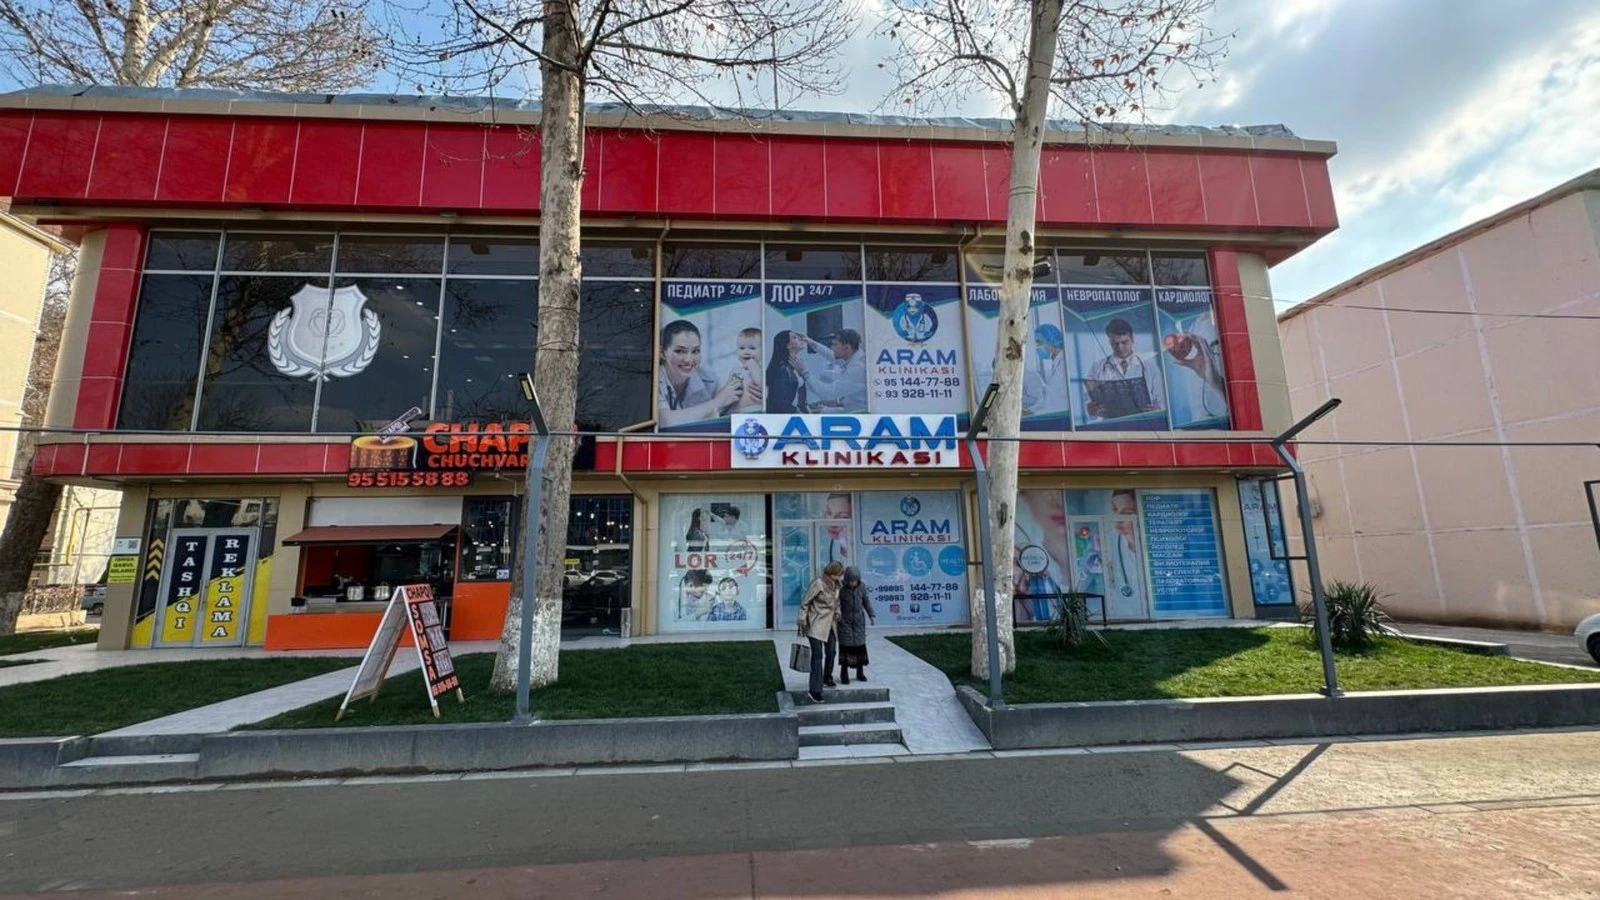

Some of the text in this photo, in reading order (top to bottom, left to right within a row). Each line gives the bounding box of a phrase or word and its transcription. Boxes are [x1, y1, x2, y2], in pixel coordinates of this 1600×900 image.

[667, 284, 754, 299] ПЕДИАТР 24/7
[770, 285, 833, 302] ЛОР 24/7
[969, 288, 1046, 301] ЛАБОИЯ
[1066, 289, 1140, 302] НЕВРОПАТОЛОГ
[1158, 290, 1211, 303] КАРДИОЛОГ
[876, 349, 956, 365] ARAM
[878, 366, 955, 375] KLINIKASI
[884, 377, 960, 387] 95 144-77-88
[885, 388, 953, 399] 93 928-11-11
[423, 421, 578, 453] CHAP
[772, 415, 956, 450] ARAM
[427, 453, 530, 468] CHUCHVAR
[782, 451, 941, 465] KLINIKASI
[348, 471, 469, 487] 95 515 58 88
[1243, 502, 1279, 511] ARM
[870, 519, 950, 535] ARAM
[872, 534, 951, 543] KLINIKASI
[674, 553, 718, 569] LOR
[175, 541, 198, 629] TASHQI
[211, 538, 240, 637] REKLAMA
[910, 582, 959, 591] 144-77-88
[910, 592, 952, 601] 928-11-11
[410, 604, 437, 681] SOMSA
